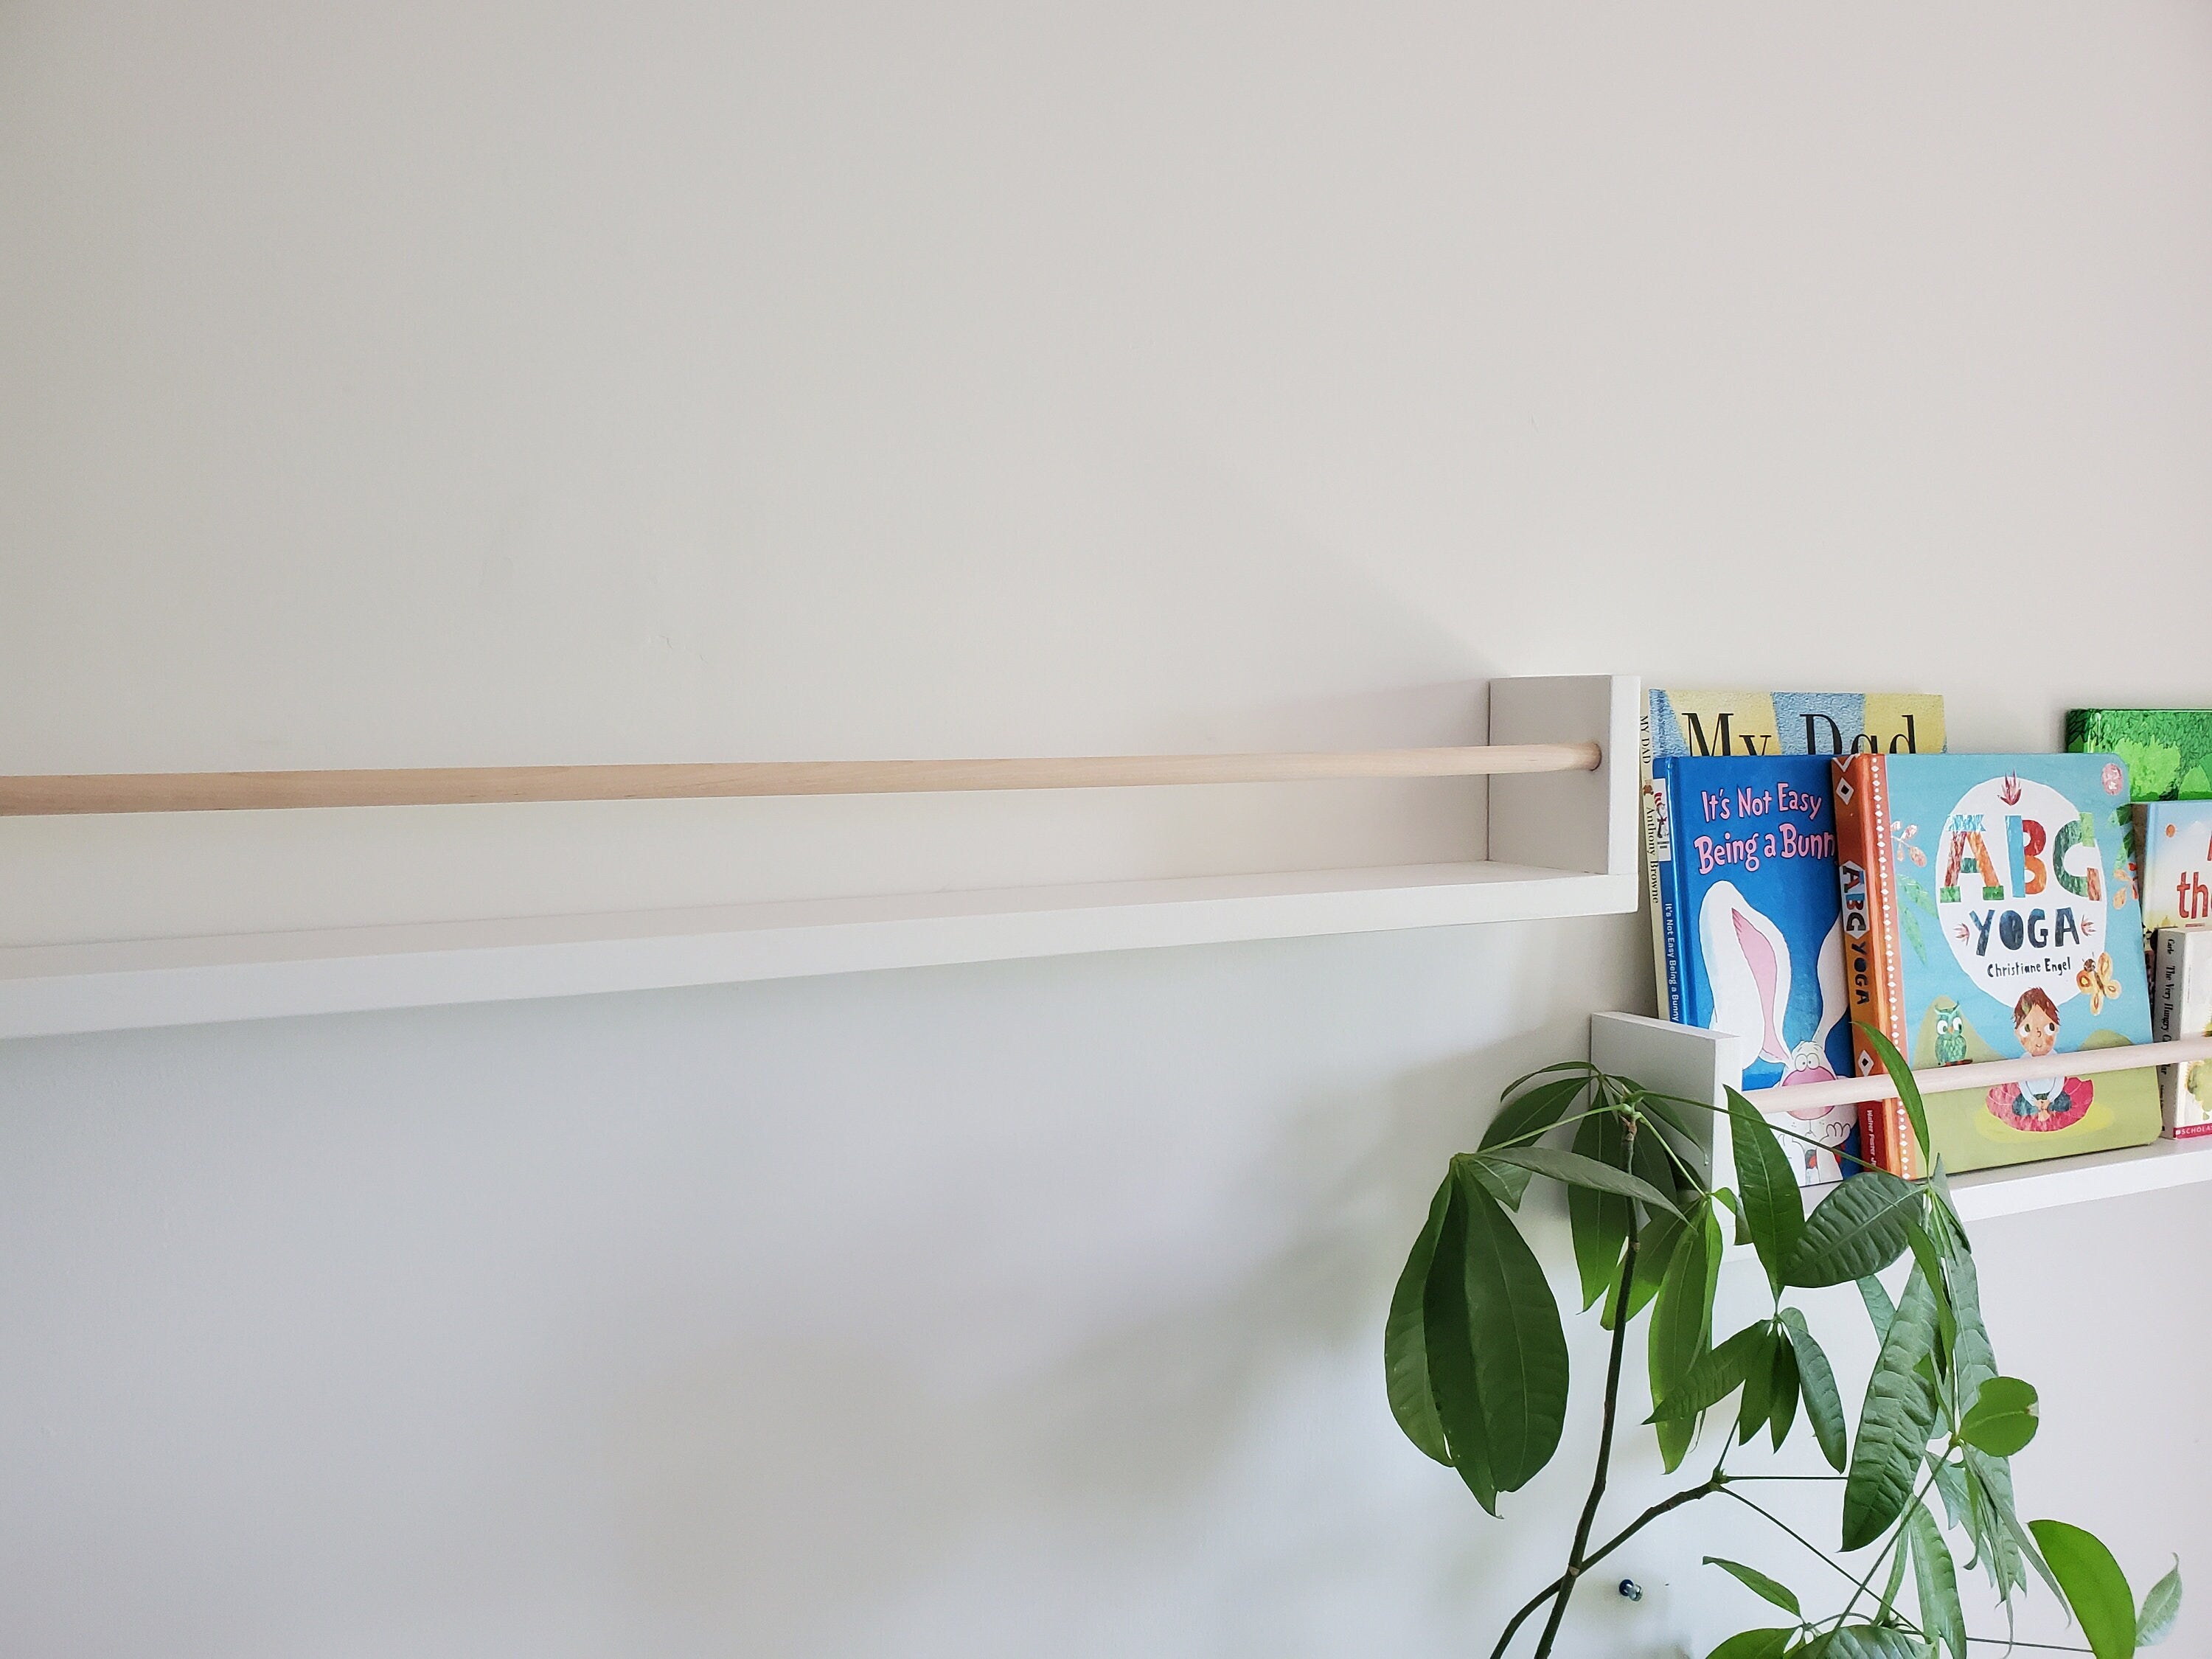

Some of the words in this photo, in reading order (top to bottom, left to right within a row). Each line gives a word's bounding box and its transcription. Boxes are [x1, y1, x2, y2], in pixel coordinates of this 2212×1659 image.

[1640, 715, 1650, 733] MY
[1799, 714, 1917, 756] Dad
[1641, 737, 1651, 764] DAD
[1701, 788, 1731, 823] It's
[1736, 785, 1773, 818] Not
[1776, 782, 1822, 821] Easy
[1646, 807, 1657, 856] Anthony
[1693, 832, 1760, 874] Being
[1764, 833, 1776, 858] a
[1778, 823, 1836, 860] Bunn
[1940, 813, 2102, 903] ABC
[1650, 860, 1659, 904] Browne
[2177, 872, 2212, 919] th
[1665, 903, 1673, 917] It's
[1843, 866, 1867, 932] ABC
[1666, 919, 1674, 936] Not
[1969, 907, 2080, 956] YOGA
[1667, 937, 1675, 959] Easy
[1669, 960, 1677, 985] Being
[1851, 941, 1871, 1005] YOGA
[1987, 961, 2041, 977] Christiane
[2044, 956, 2070, 975] Engel
[2166, 965, 2175, 981] The
[2162, 983, 2174, 999] Very
[1672, 994, 1680, 1022] Bunny
[2160, 1003, 2174, 1032] Hungry
[2181, 1125, 2212, 1135] SCHOLA
